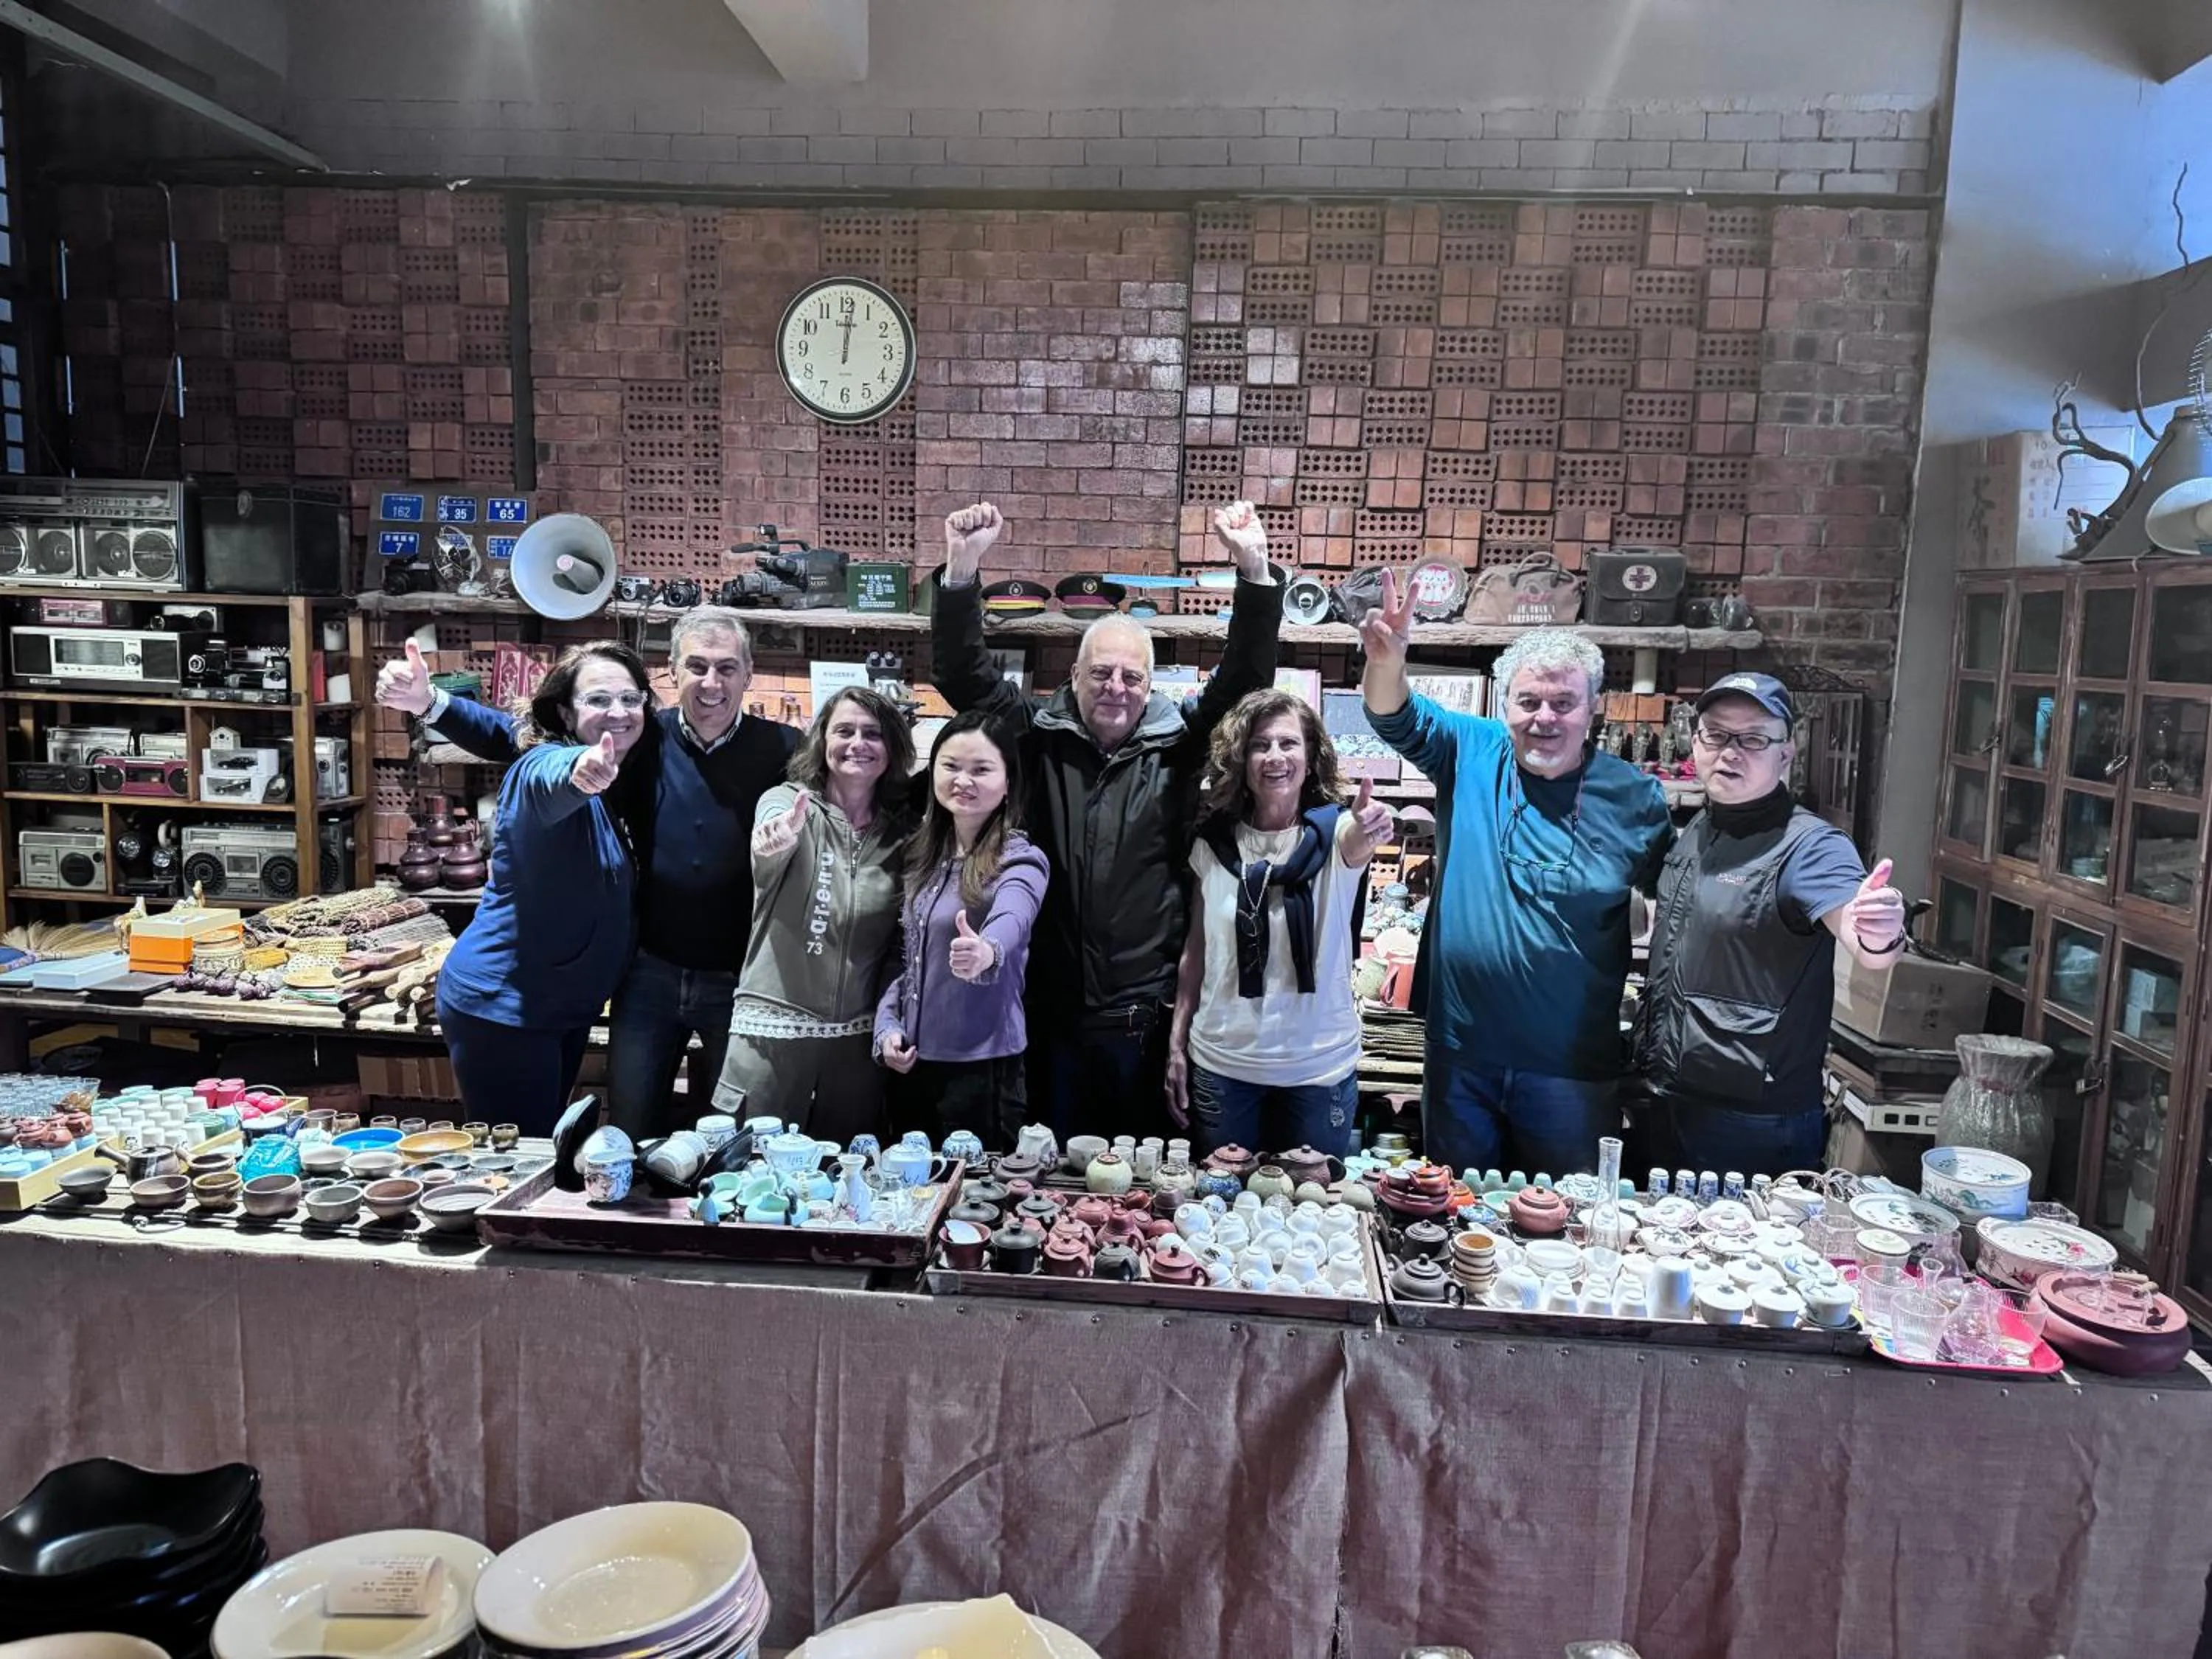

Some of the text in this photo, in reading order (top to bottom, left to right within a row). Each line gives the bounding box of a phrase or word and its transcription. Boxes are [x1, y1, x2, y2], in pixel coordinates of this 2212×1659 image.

[819, 303, 830, 319] 11
[840, 296, 855, 313] 12
[865, 304, 870, 320] 1
[803, 319, 818, 335] 10
[878, 321, 888, 338] 2
[799, 340, 809, 357] 9
[883, 344, 893, 361] 3
[804, 362, 813, 379] 8
[877, 367, 888, 383] 4
[819, 380, 828, 397] 7
[840, 388, 850, 404] 6
[861, 383, 872, 399] 5
[392, 507, 411, 518] 162
[454, 508, 467, 520] 35
[499, 509, 515, 520] 65
[395, 543, 403, 554] 7
[807, 942, 824, 955] 73
